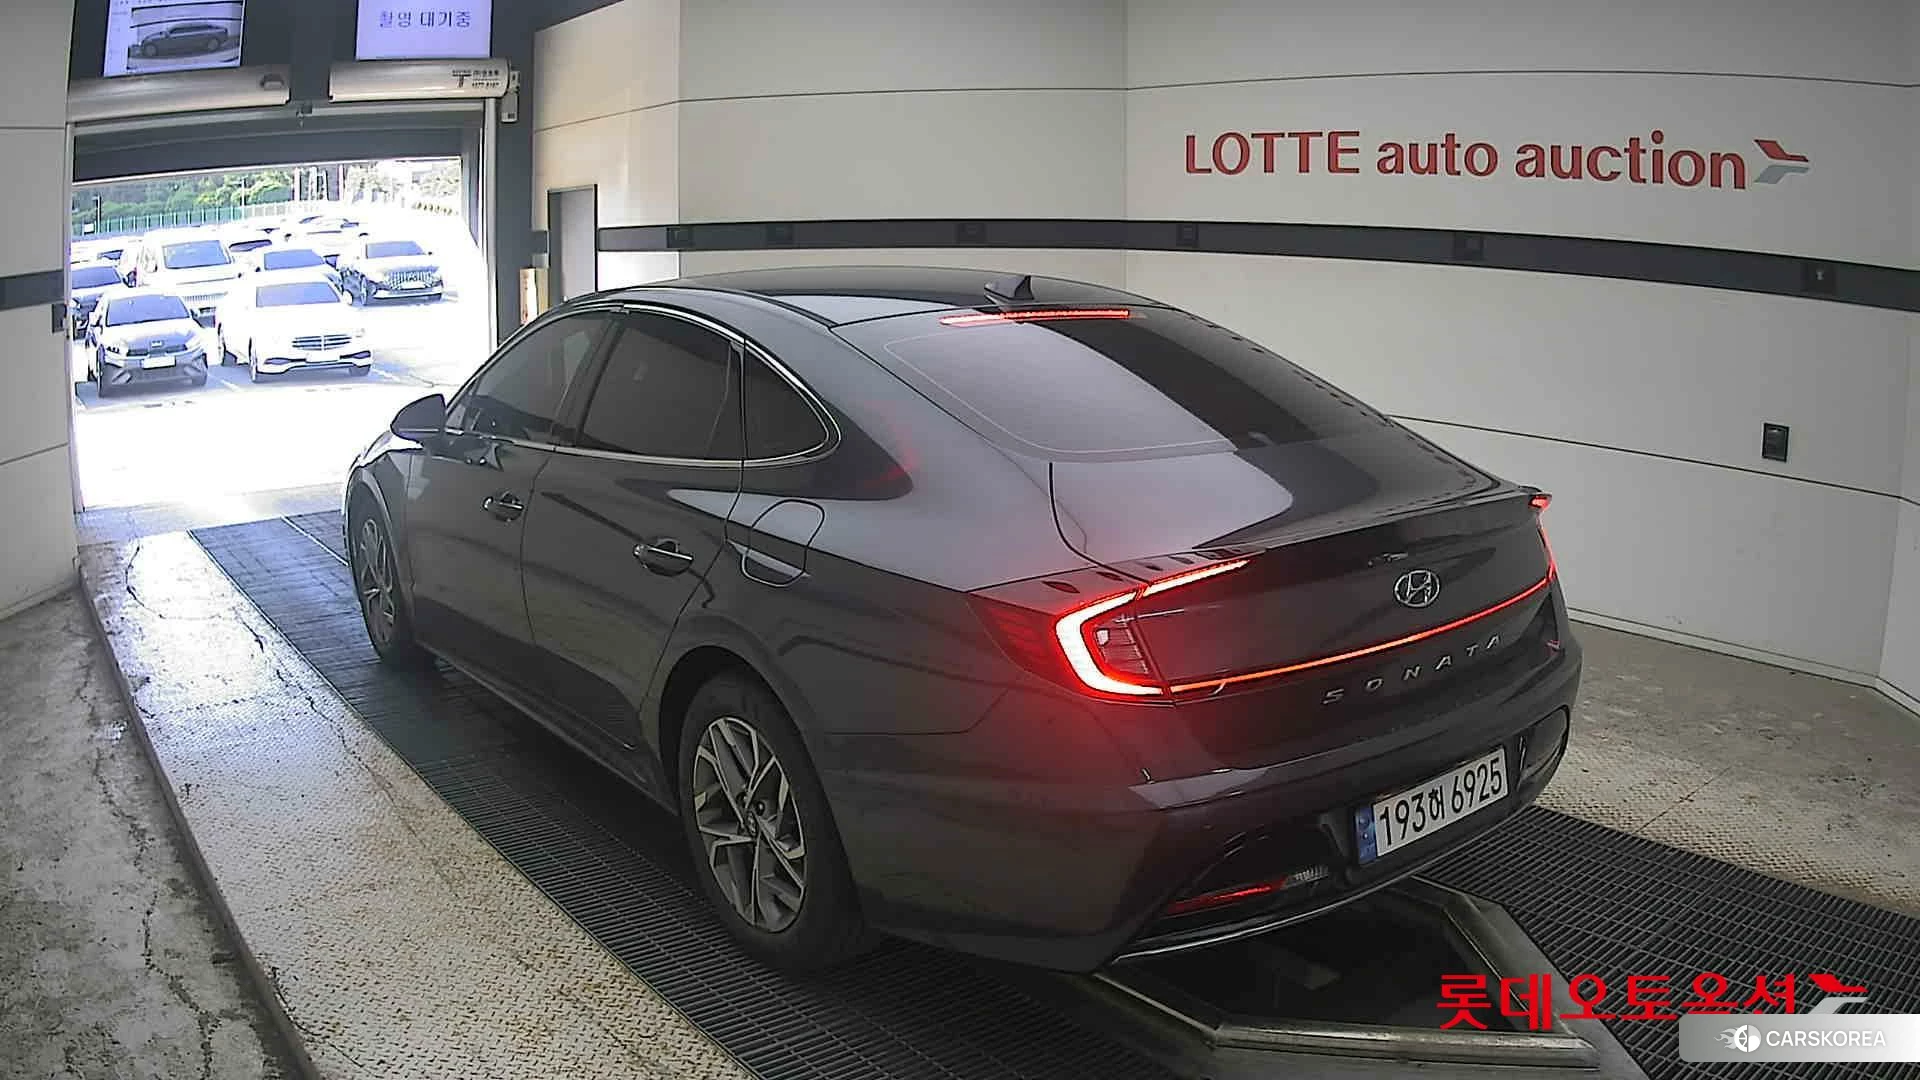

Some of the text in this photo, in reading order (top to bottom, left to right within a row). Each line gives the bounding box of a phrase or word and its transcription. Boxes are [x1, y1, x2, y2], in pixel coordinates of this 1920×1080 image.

[420, 10, 471, 28] 대기중
[1186, 130, 1746, 189] LOTTE auto auction
[1322, 634, 1501, 705] SONATA
[1380, 757, 1502, 846] 193허 6925
